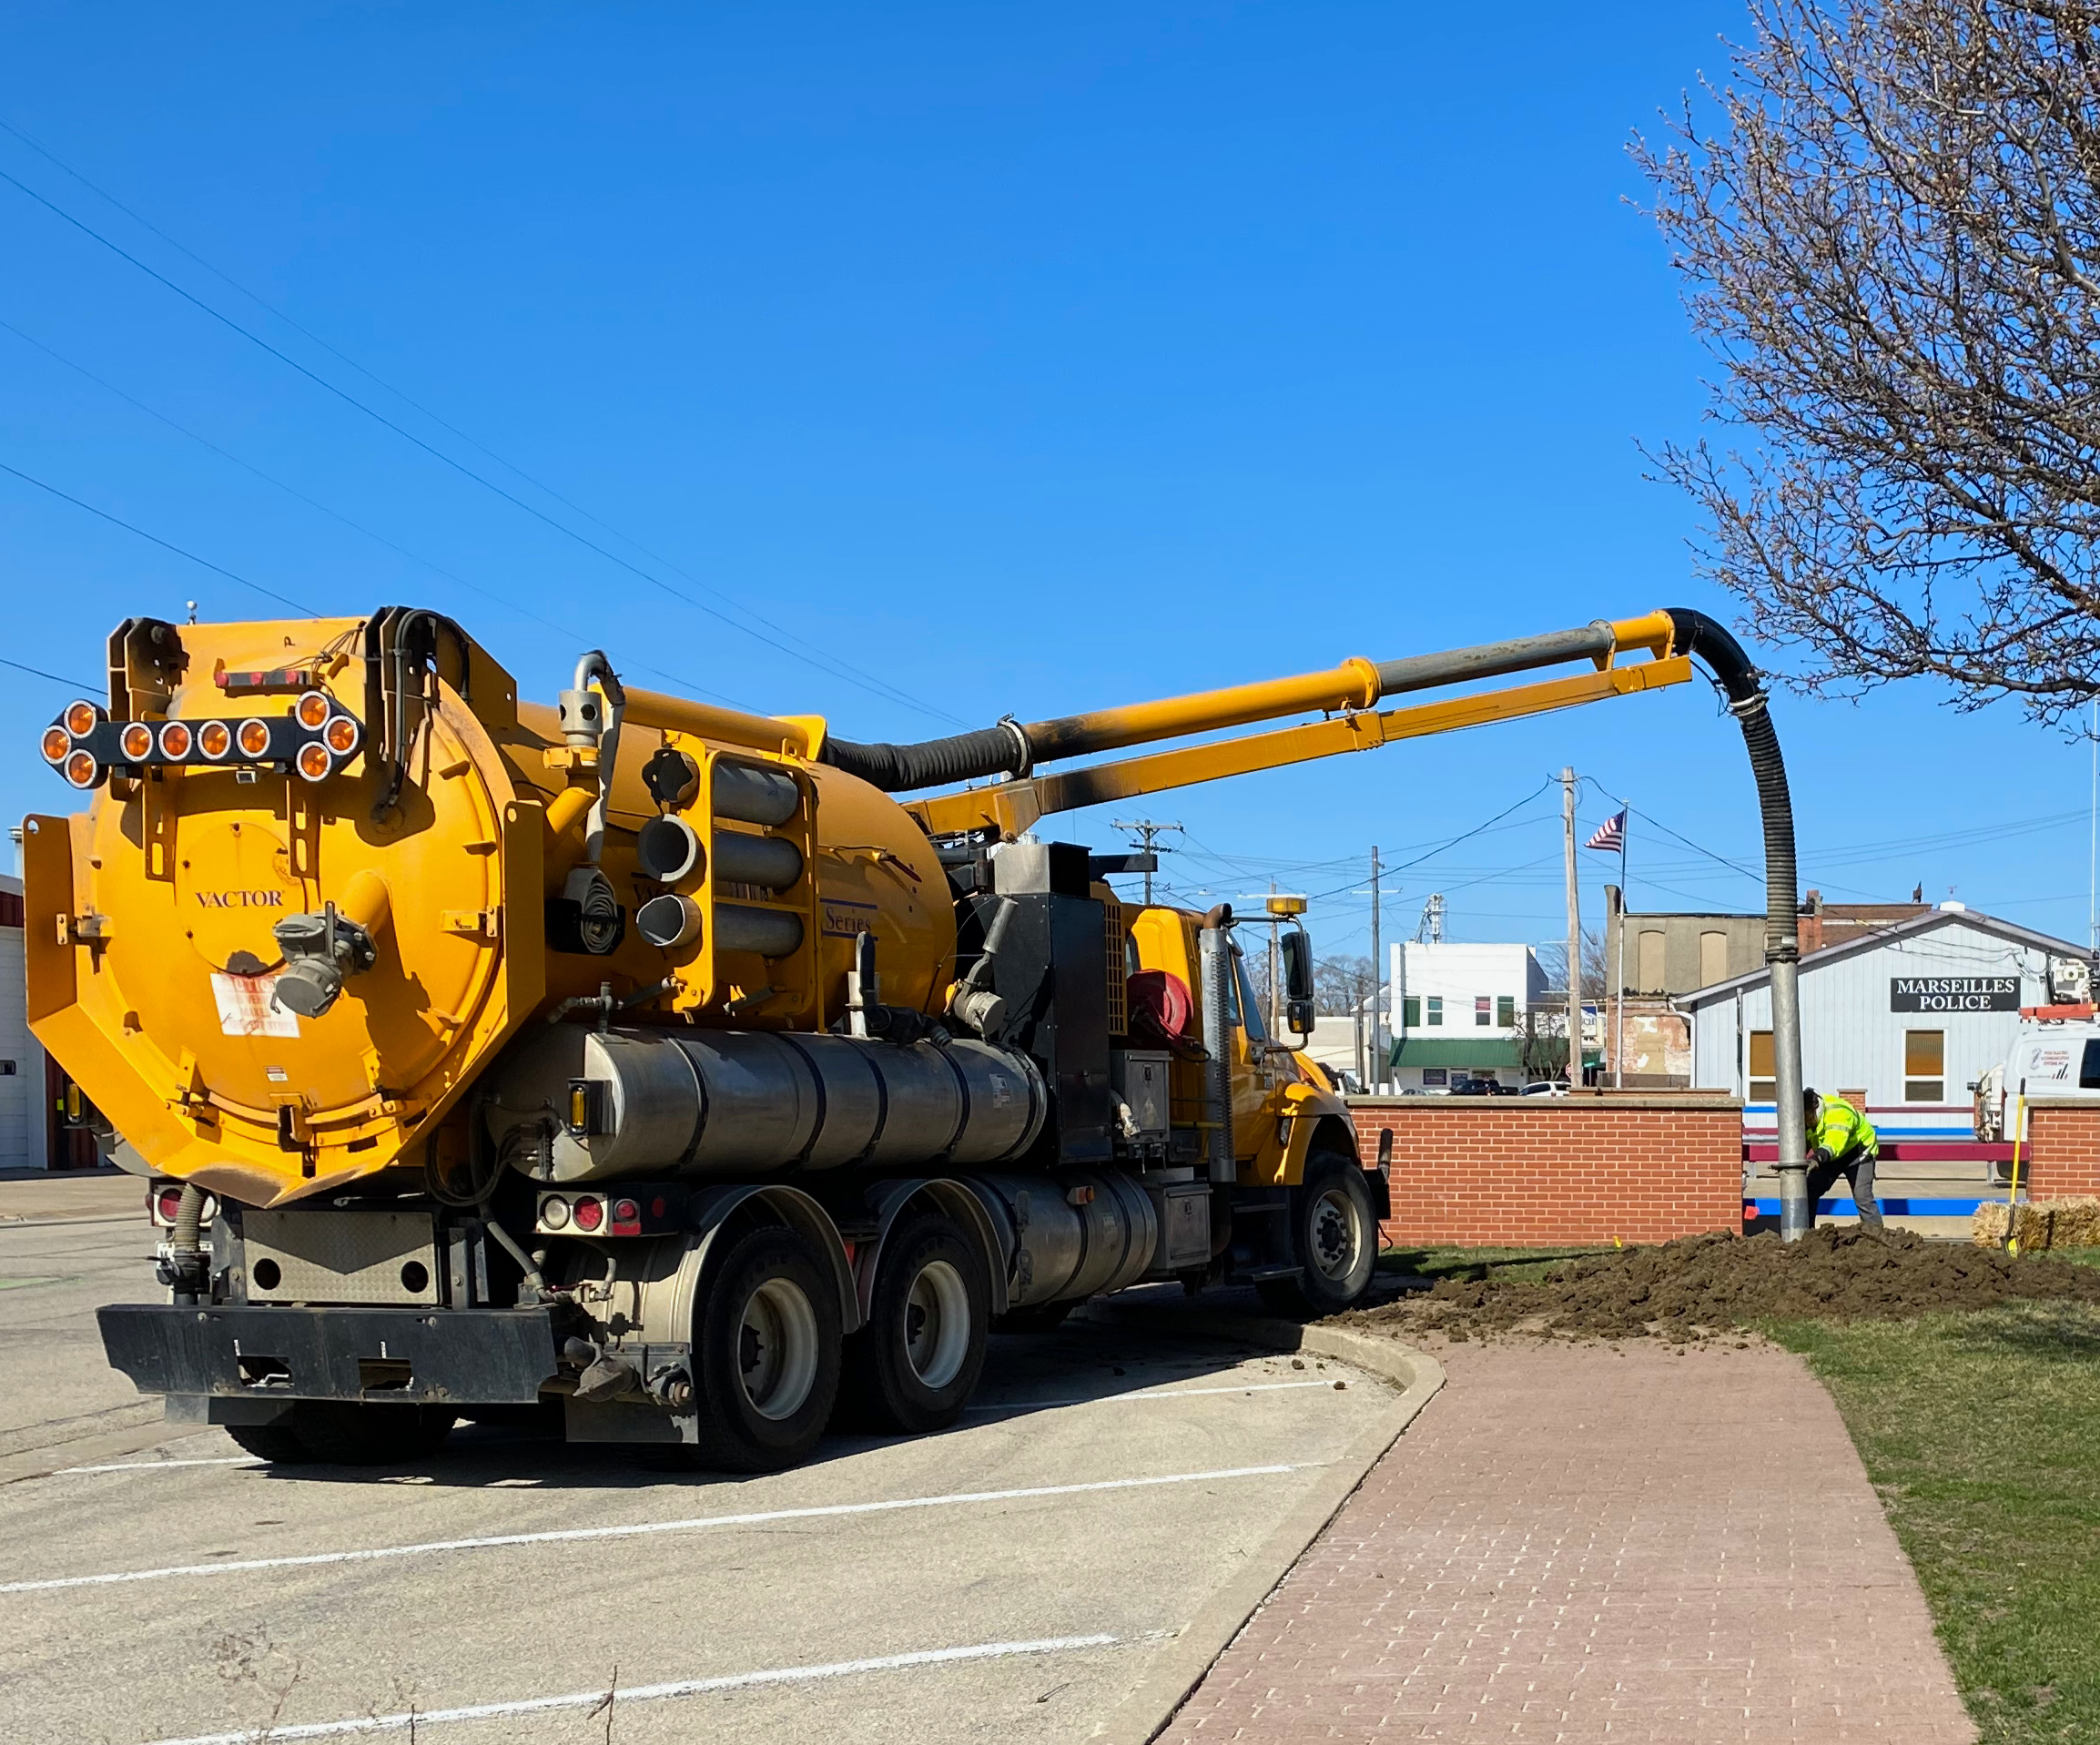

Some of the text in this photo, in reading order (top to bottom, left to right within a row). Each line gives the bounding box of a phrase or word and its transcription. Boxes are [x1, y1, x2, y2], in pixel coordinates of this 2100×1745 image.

[195, 889, 284, 908] VACTOR
[826, 906, 871, 934] Series
[1897, 979, 2015, 994] MARSEILLES
[1919, 995, 1992, 1010] POLICE
